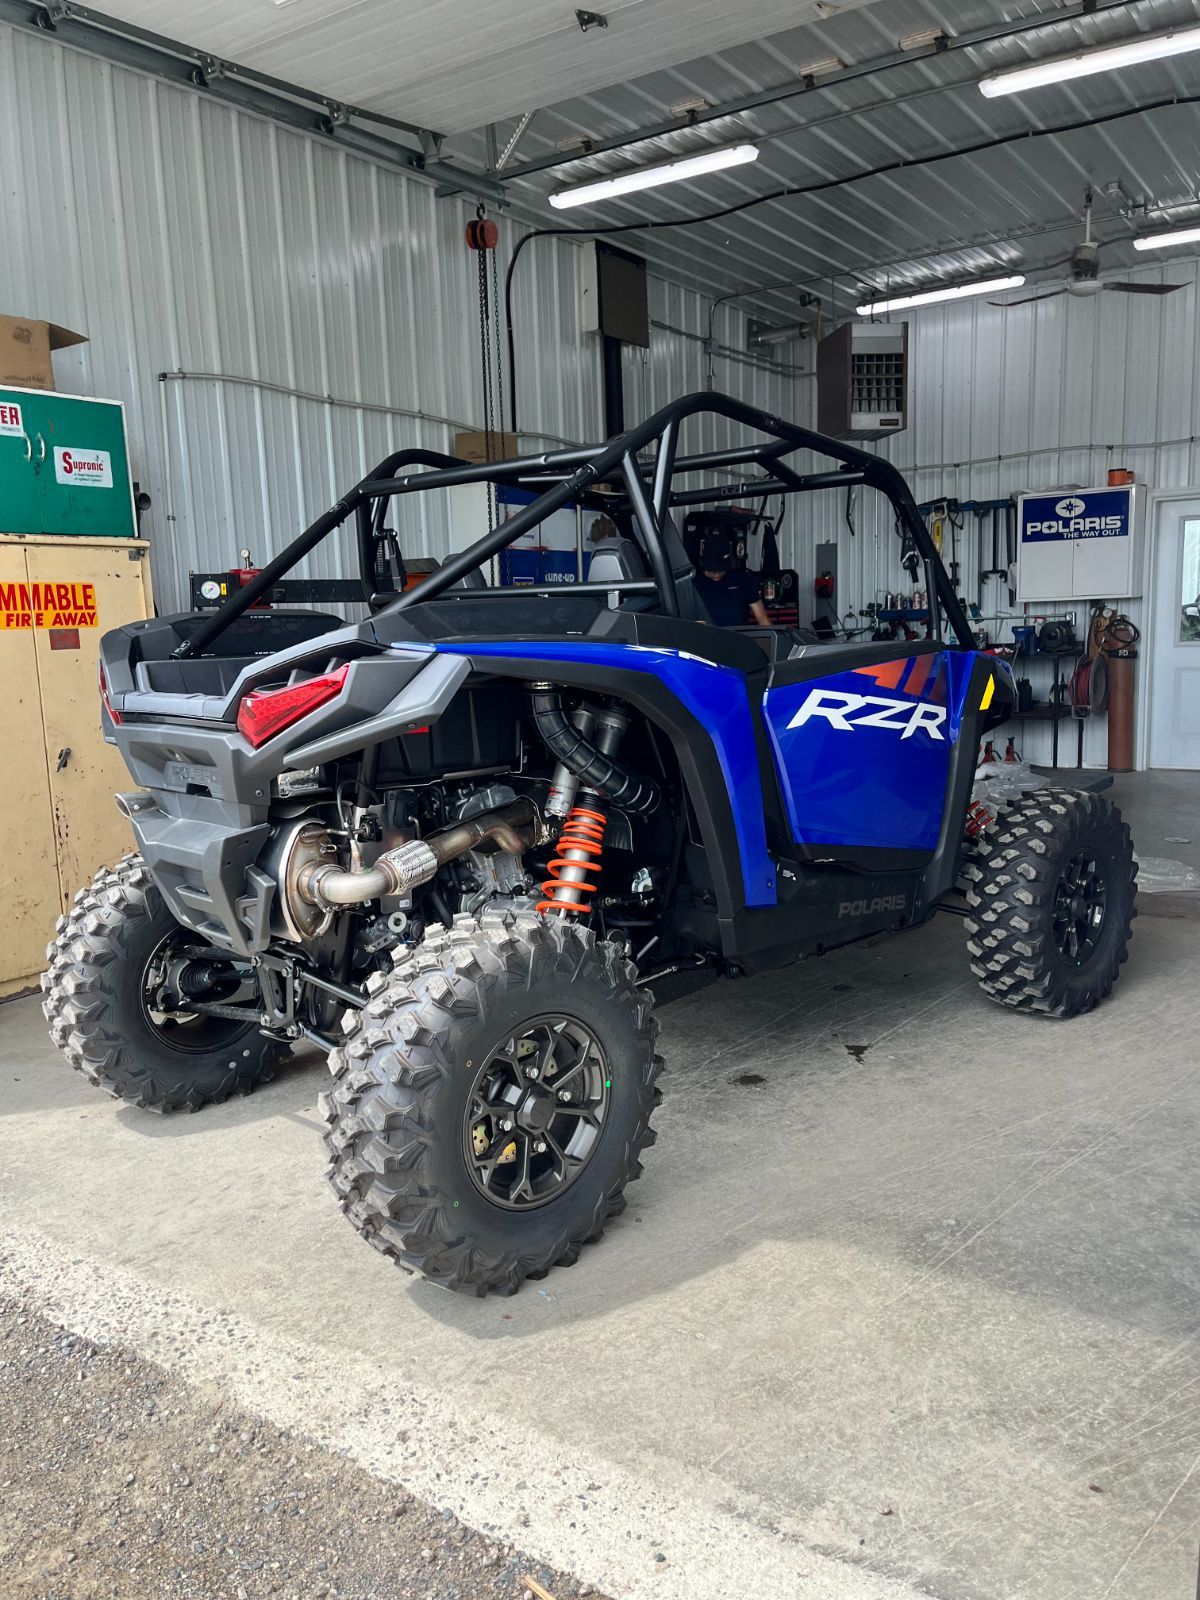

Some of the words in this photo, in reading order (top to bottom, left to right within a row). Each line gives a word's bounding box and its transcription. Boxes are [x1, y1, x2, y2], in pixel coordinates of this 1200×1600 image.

[0, 405, 20, 426] ER
[62, 450, 104, 475] Supronic
[1026, 516, 1122, 536] POLARIS
[1063, 531, 1080, 539] THE
[1081, 530, 1100, 538] WAY
[6, 613, 44, 627] FIRE
[52, 612, 97, 626] AWAY
[785, 688, 947, 740] RZR
[838, 894, 906, 919] POLARIS
